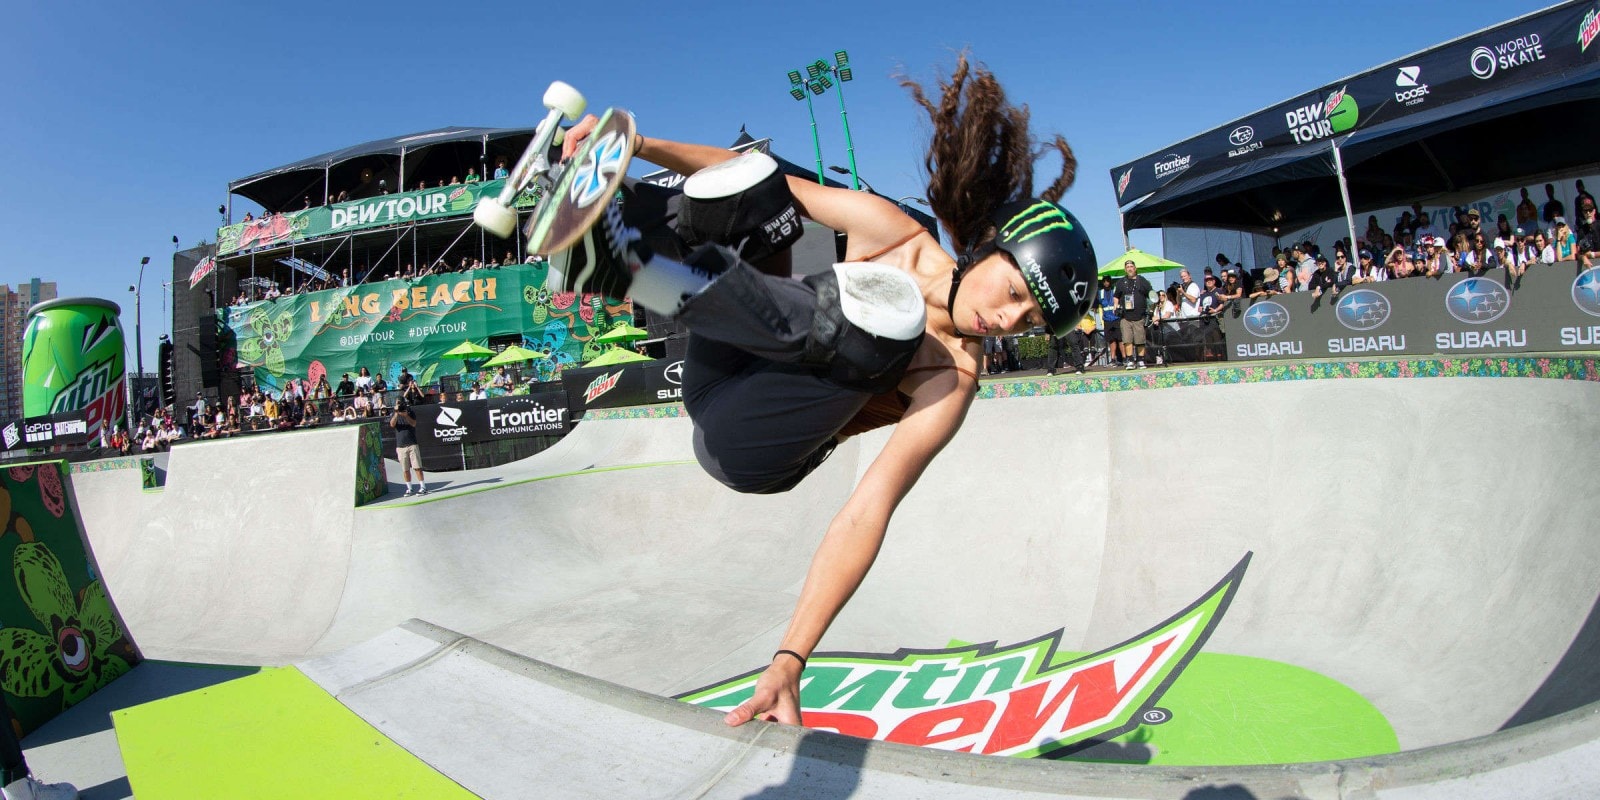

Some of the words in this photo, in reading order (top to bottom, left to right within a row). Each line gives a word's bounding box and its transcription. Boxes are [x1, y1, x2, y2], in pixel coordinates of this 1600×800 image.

[1495, 34, 1540, 56] WORLD
[1498, 45, 1546, 71] SKATE
[1395, 84, 1430, 103] boost
[1286, 101, 1324, 129] DEW
[1290, 118, 1334, 145] TOUR
[1228, 141, 1264, 159] SUBARU
[1154, 155, 1191, 175] Frontier
[331, 201, 386, 228] DEW
[385, 193, 448, 220] TOUR
[392, 277, 497, 311] BEACH
[340, 329, 395, 347] @DEWTOUR
[408, 321, 468, 338] #DEWTOUR
[1328, 334, 1406, 354] SUBARU
[1437, 329, 1527, 350] SUBARU
[1236, 340, 1303, 357] SUBARU
[488, 404, 568, 428] Frontier
[434, 425, 468, 438] boost
[490, 422, 563, 436] COMMUNICATIONS
